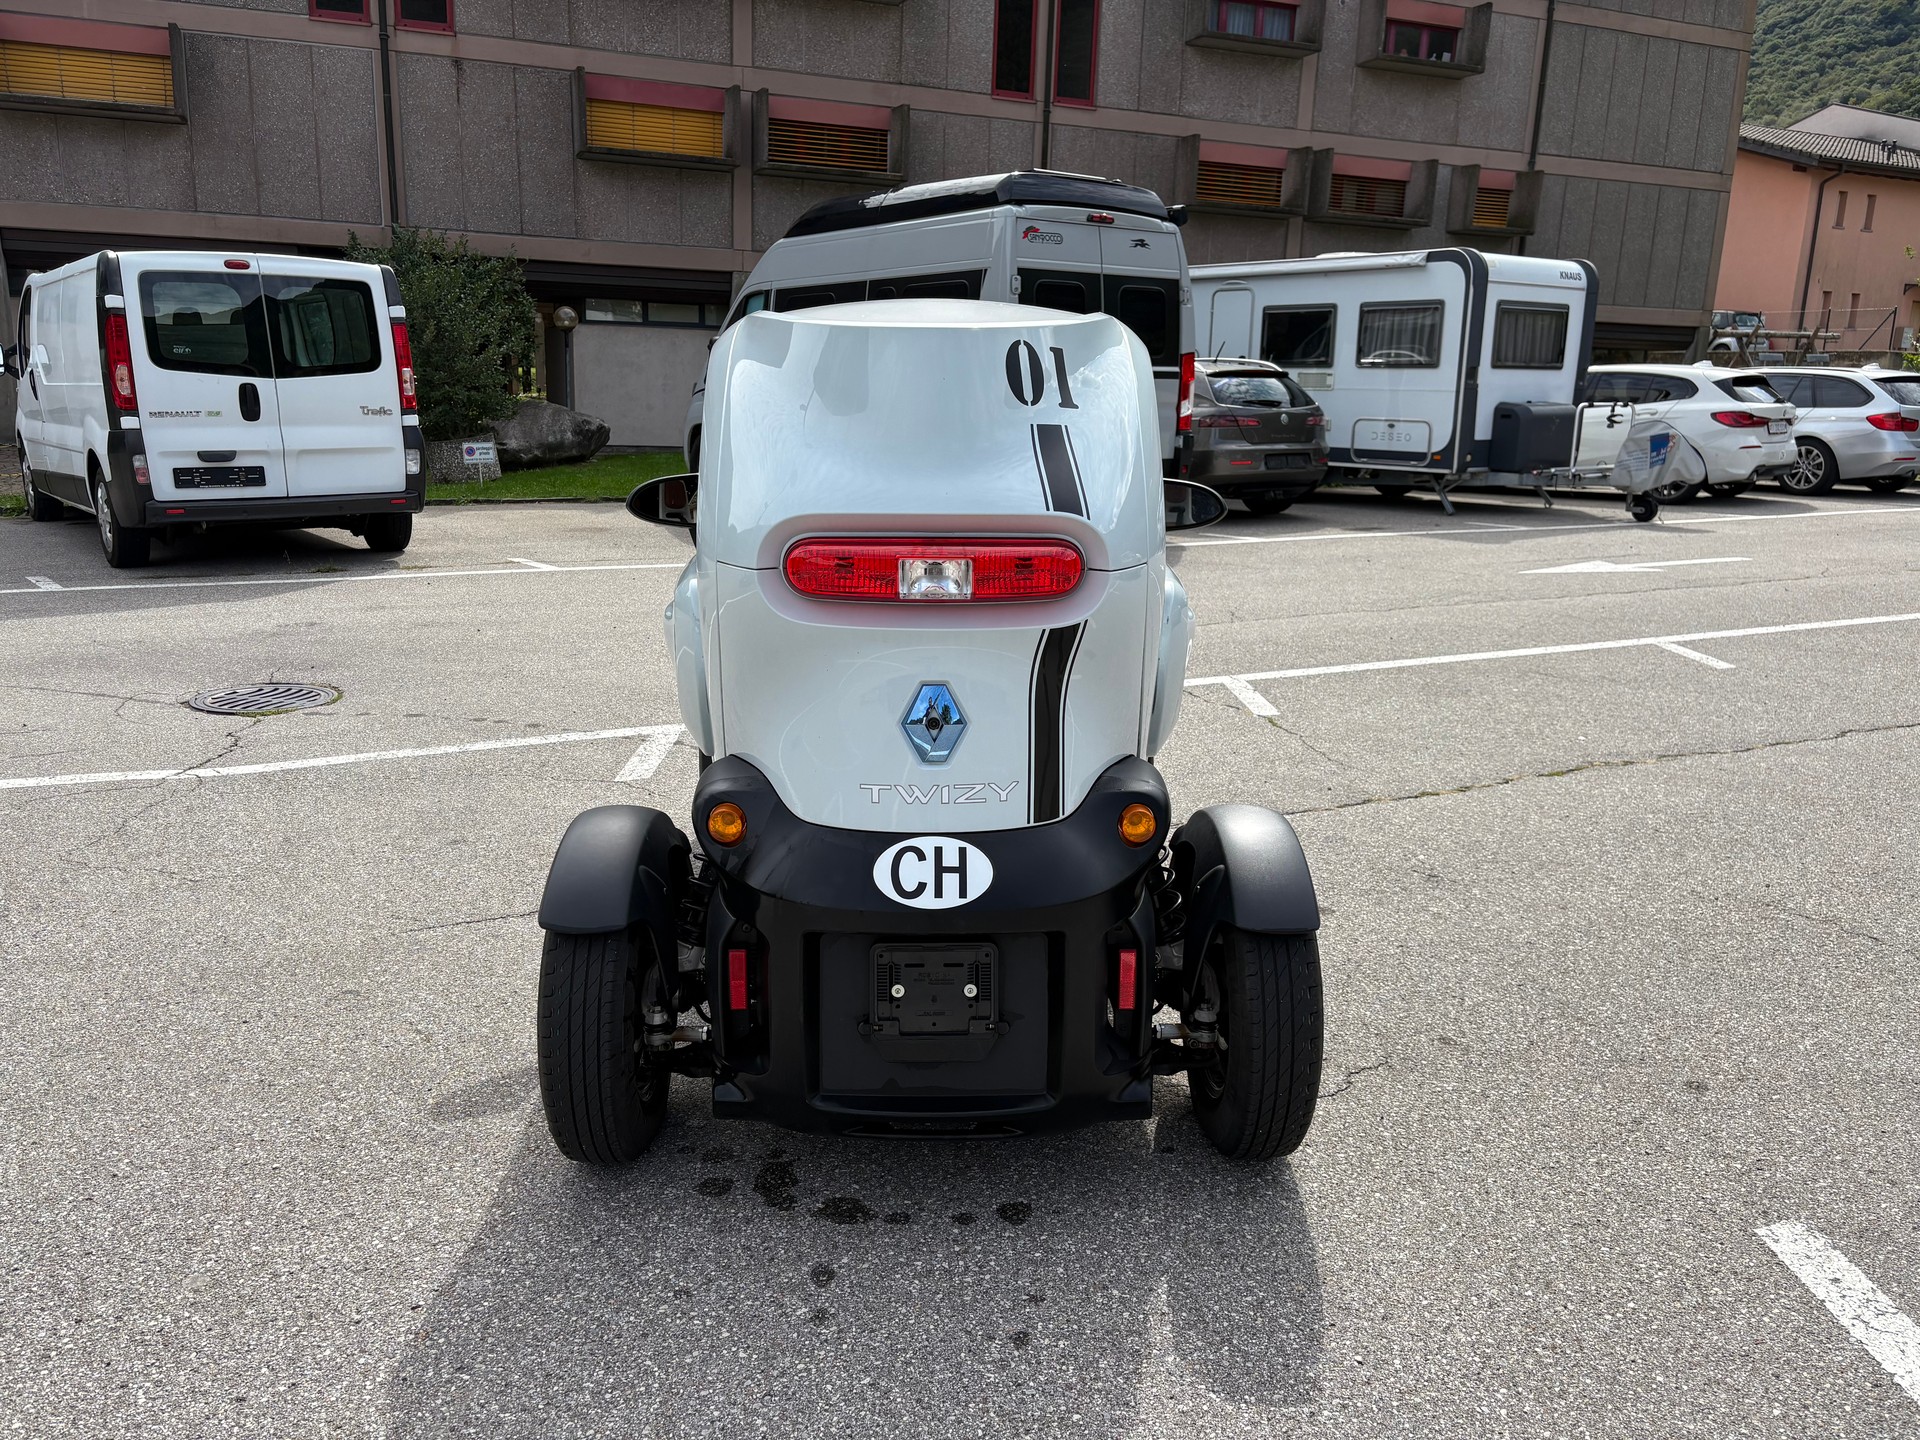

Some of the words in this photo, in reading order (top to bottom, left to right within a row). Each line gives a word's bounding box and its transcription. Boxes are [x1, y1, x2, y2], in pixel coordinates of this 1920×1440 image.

[1560, 271, 1582, 281] KNAUS
[1005, 339, 1079, 409] 01
[360, 405, 393, 416] Trafic
[1371, 431, 1411, 442] DESEO
[859, 780, 1019, 804] TWIZY
[890, 845, 968, 900] CH
